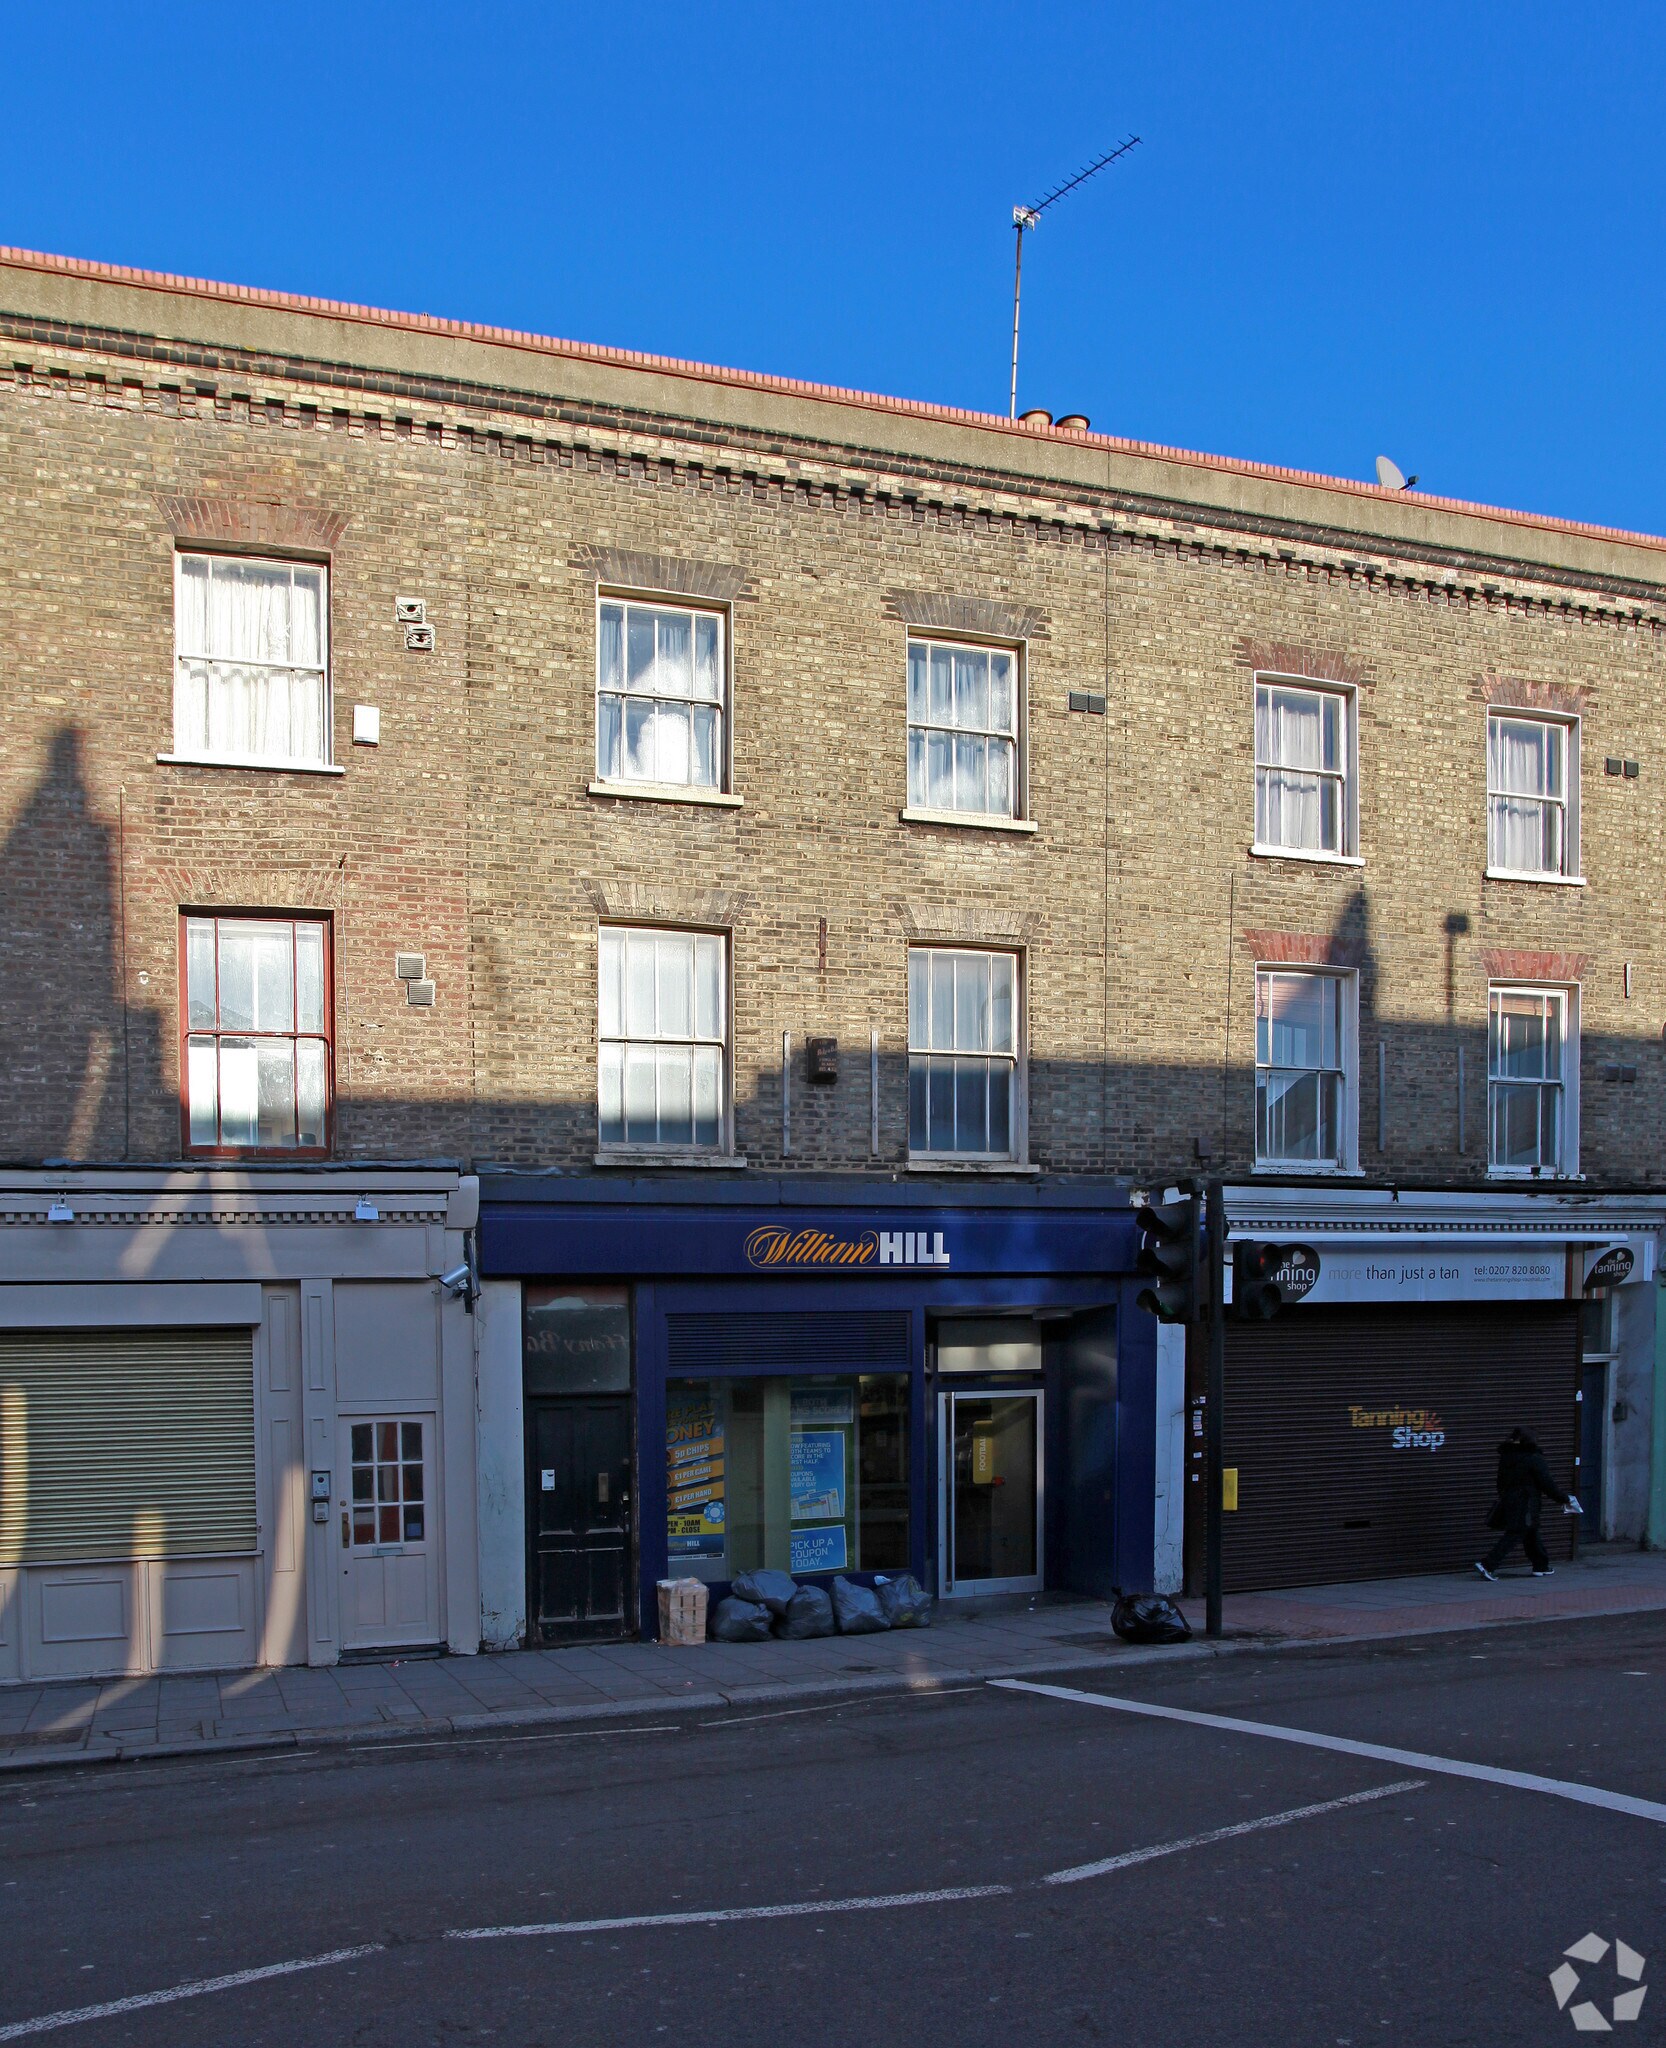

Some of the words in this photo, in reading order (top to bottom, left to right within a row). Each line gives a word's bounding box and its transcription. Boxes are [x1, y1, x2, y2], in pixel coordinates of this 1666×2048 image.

[743, 1225, 879, 1267] William
[880, 1231, 950, 1264] HILL
[1511, 1265, 1528, 1275] 820
[1529, 1265, 1551, 1275] 8080
[1595, 1260, 1632, 1274] tanning
[1328, 1268, 1361, 1280] more
[1366, 1265, 1396, 1280] than
[1398, 1265, 1424, 1285] just
[1428, 1268, 1436, 1280] a
[1440, 1266, 1459, 1280] tan
[1287, 1281, 1308, 1292] shop
[1348, 1402, 1426, 1431] Tanning
[666, 1418, 714, 1444] ONEY
[1392, 1426, 1445, 1452] Shop
[687, 1444, 710, 1456] CHIPS
[683, 1492, 695, 1501] PER
[695, 1489, 712, 1499] HAND
[812, 1539, 825, 1547] UP
[827, 1538, 834, 1546] A
